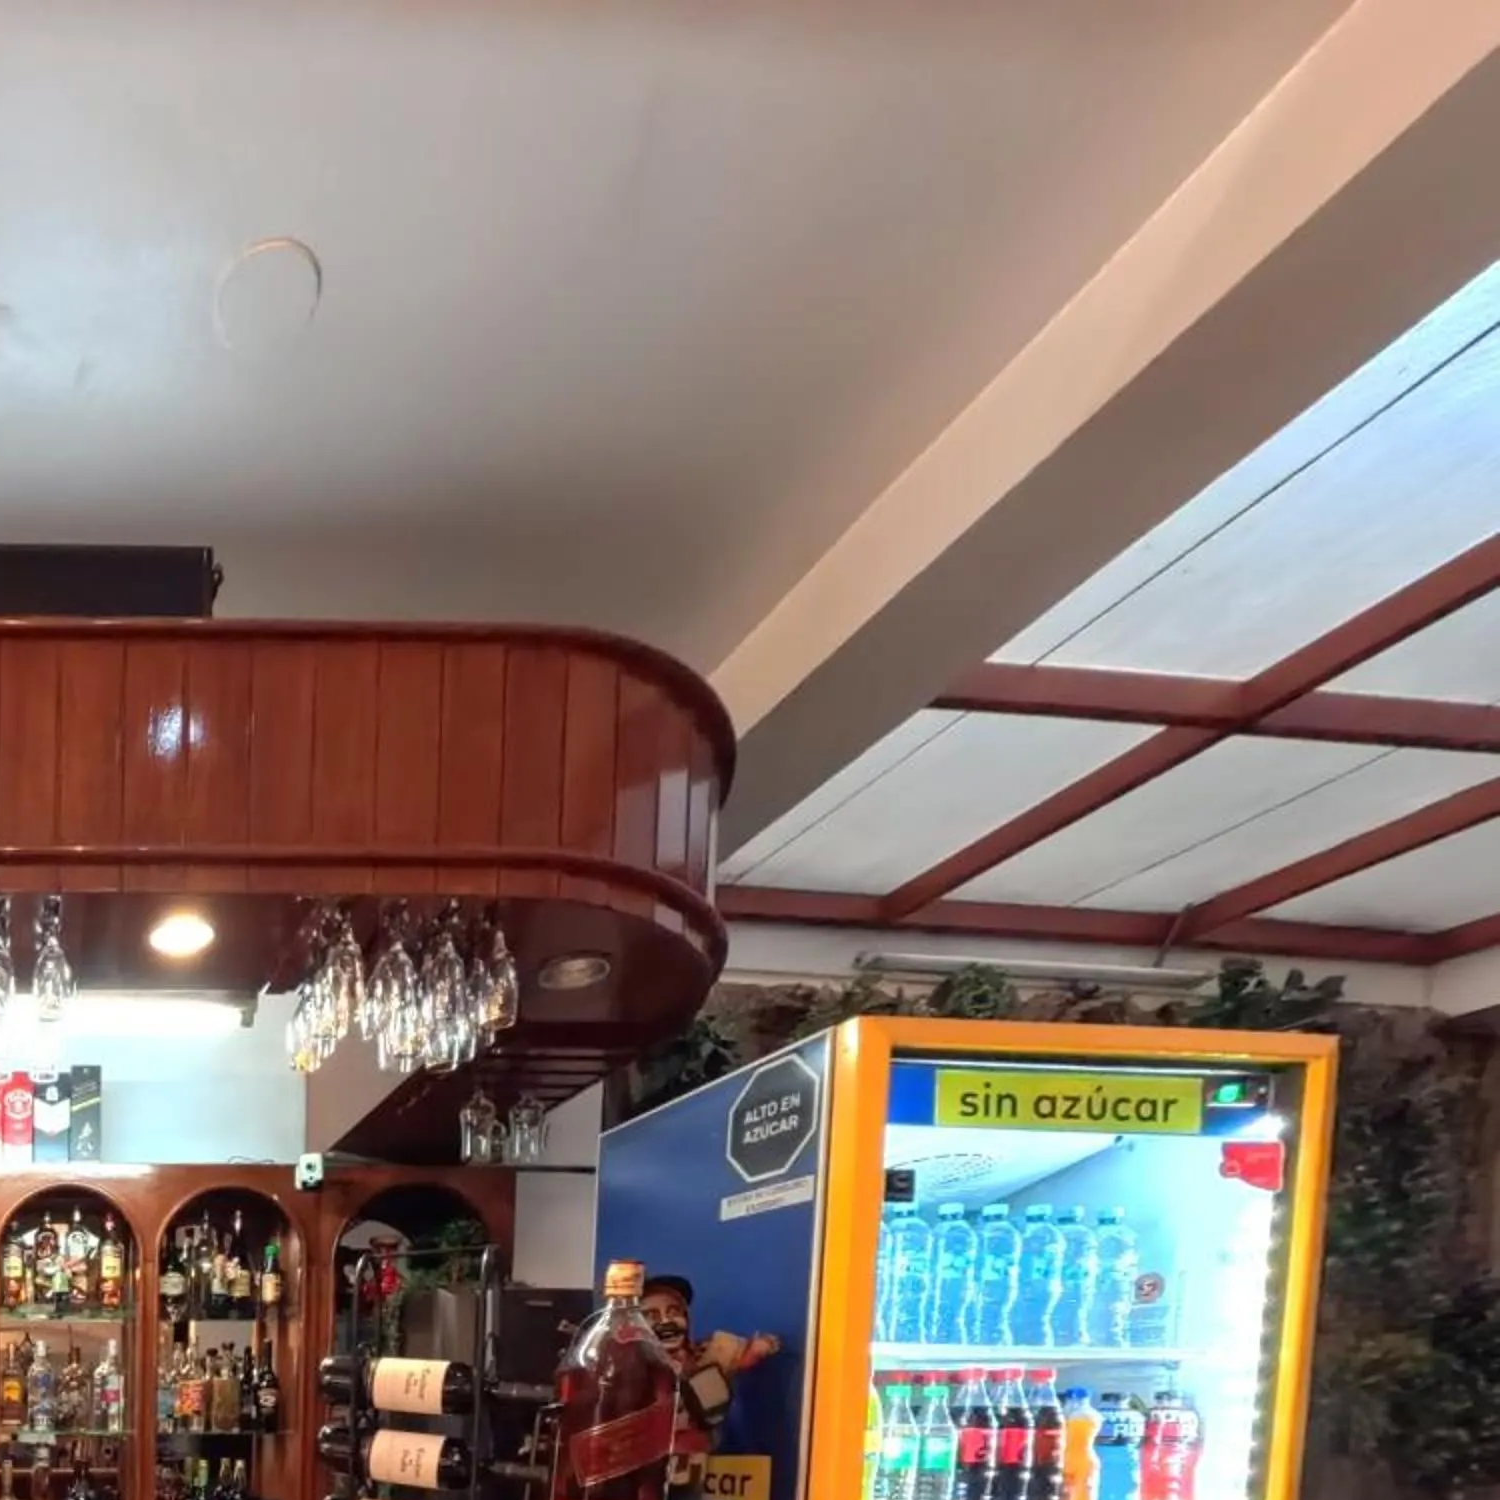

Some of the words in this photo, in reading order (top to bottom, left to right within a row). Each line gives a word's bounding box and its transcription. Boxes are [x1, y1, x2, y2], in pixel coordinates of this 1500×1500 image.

[744, 1100, 779, 1125] ALTO
[781, 1091, 801, 1111] EN
[959, 1081, 1018, 1118] sin
[1032, 1085, 1178, 1123] azúcar
